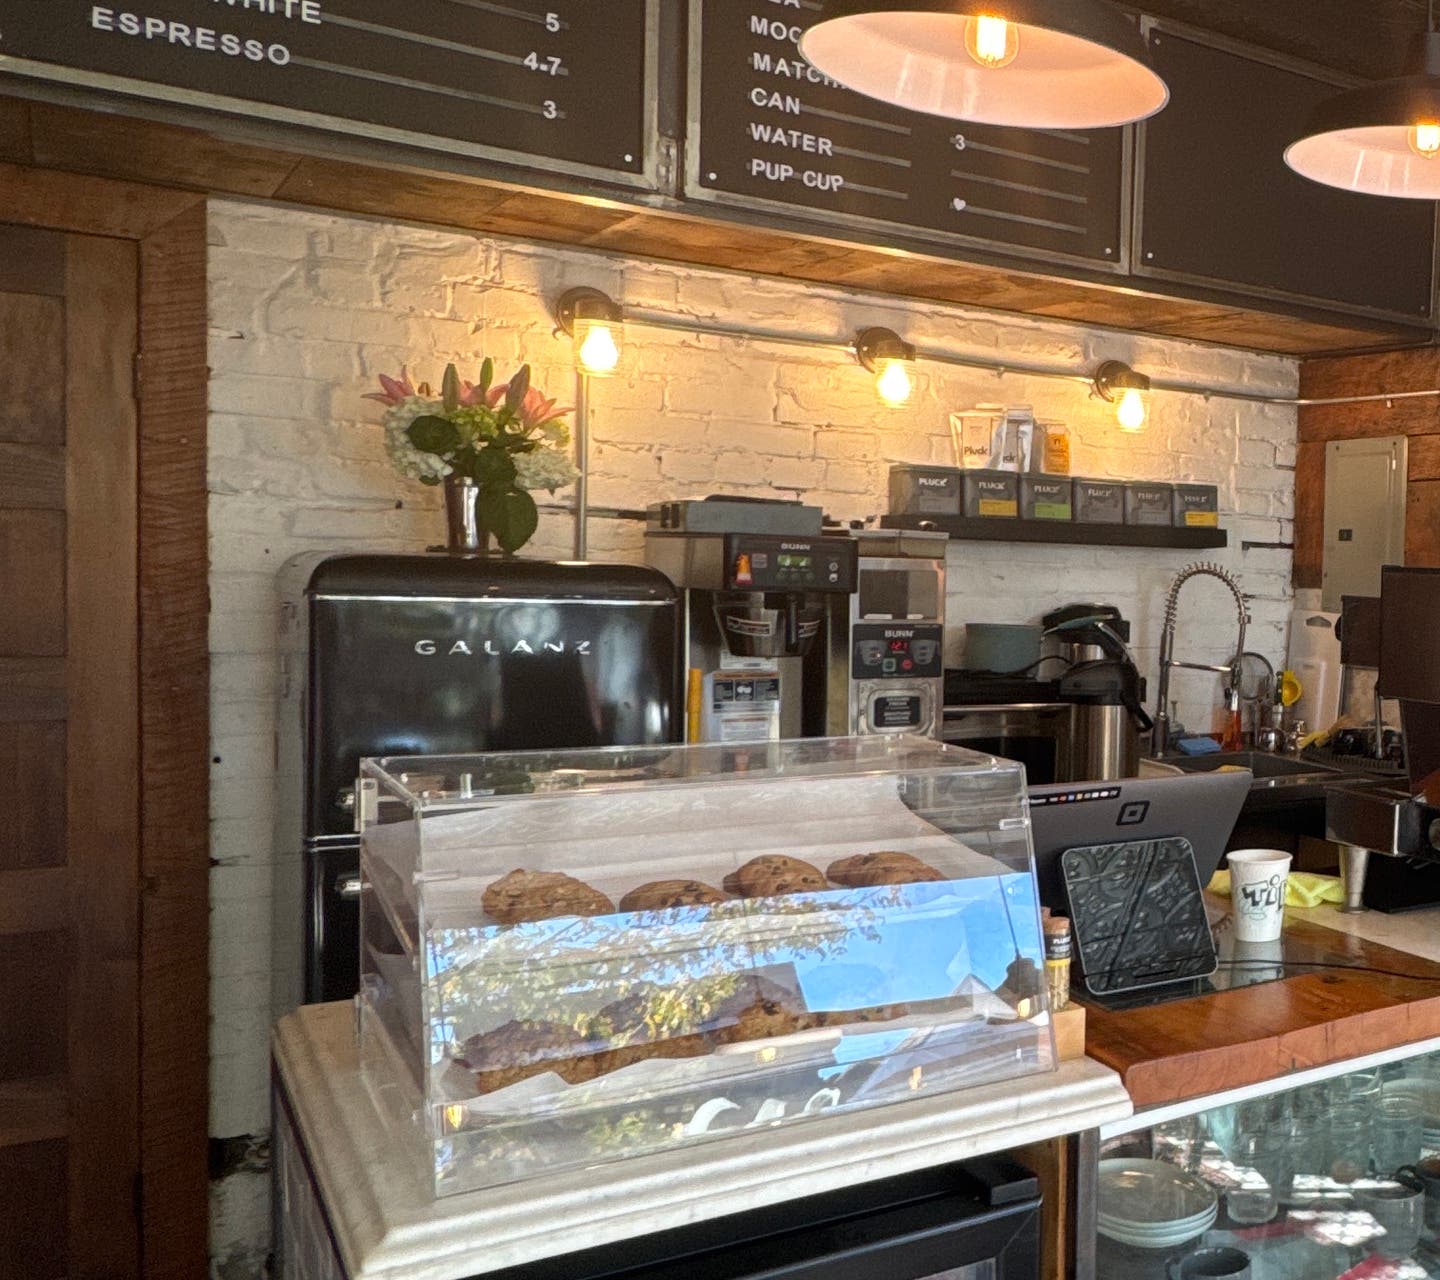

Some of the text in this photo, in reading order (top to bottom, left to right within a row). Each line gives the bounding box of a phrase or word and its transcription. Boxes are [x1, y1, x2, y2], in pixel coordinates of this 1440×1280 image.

[546, 13, 560, 32] 5
[751, 15, 802, 43] MOC
[92, 6, 557, 119] ESPRESSO 3
[753, 52, 846, 89] MATC
[751, 88, 966, 150] CAN 3
[750, 122, 833, 156] WATER
[751, 159, 844, 192] PUP CUP
[919, 477, 948, 487] PLUCK
[415, 639, 590, 655] GALANZ
